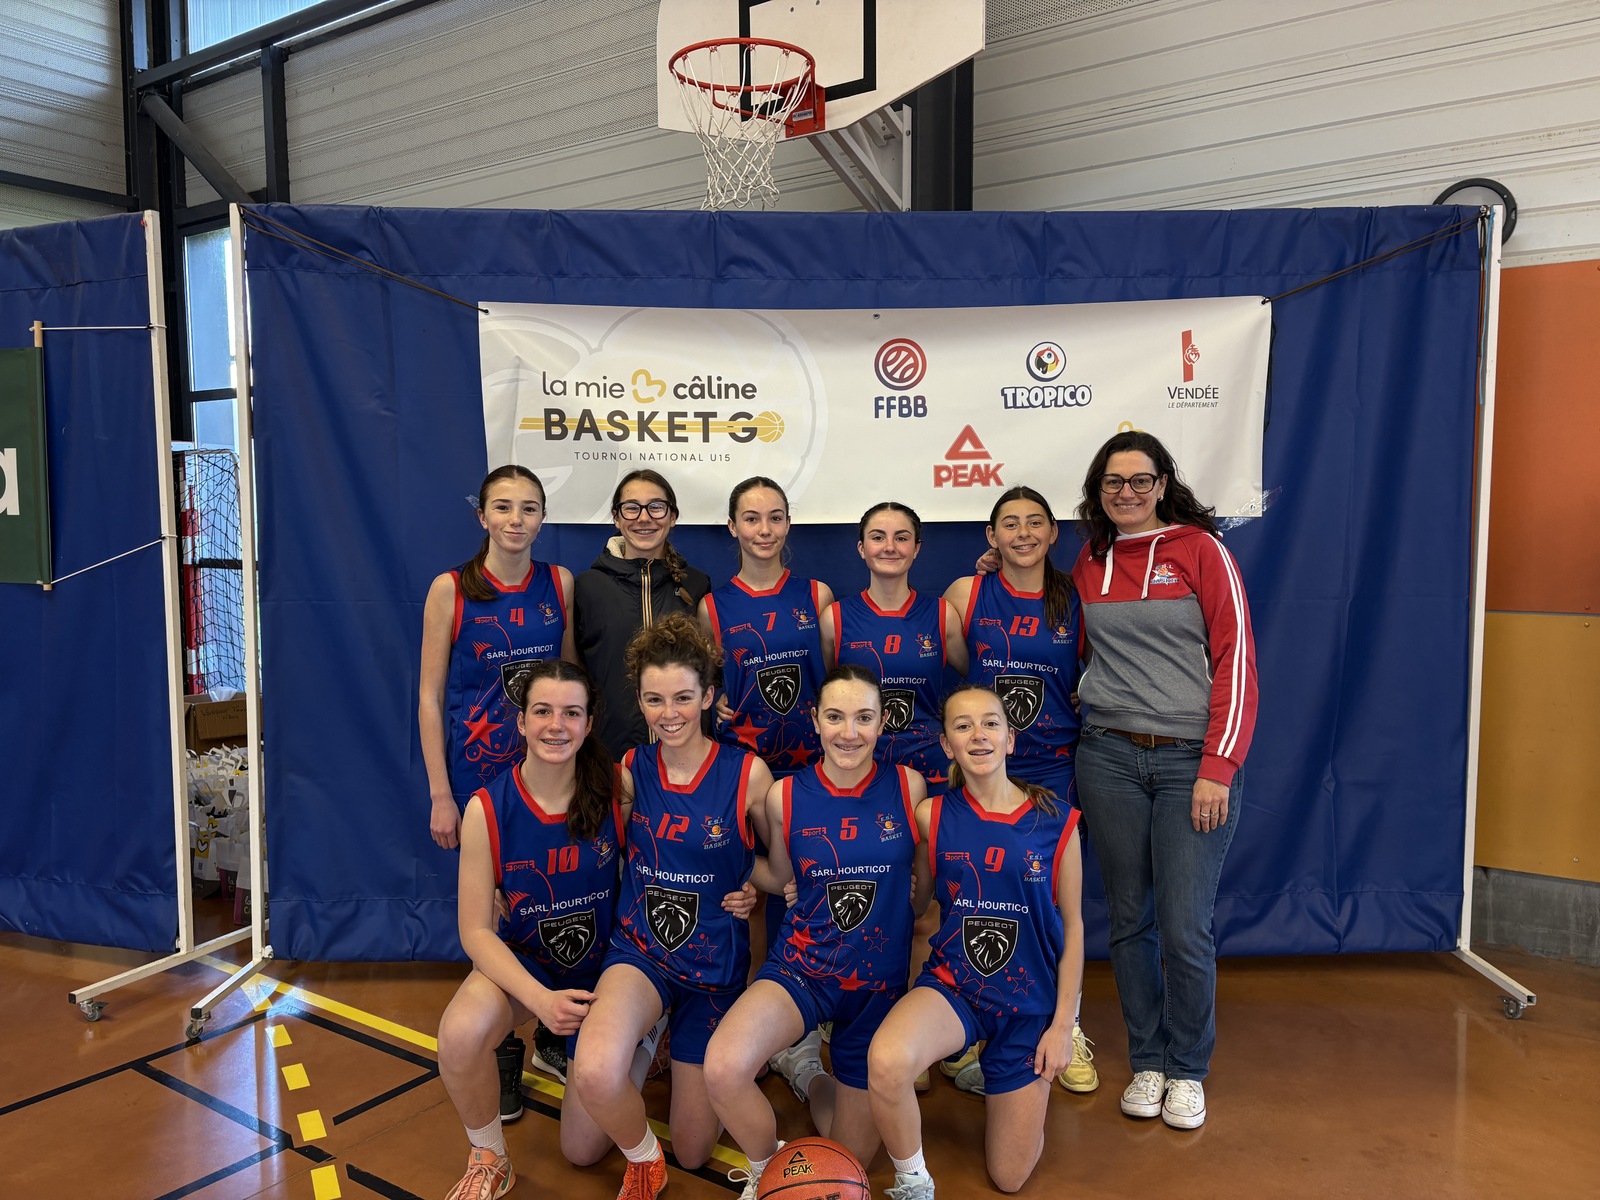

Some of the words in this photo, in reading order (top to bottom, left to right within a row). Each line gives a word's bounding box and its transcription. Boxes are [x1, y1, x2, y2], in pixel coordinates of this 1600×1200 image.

[542, 371, 567, 396] la
[575, 375, 625, 399] mie
[673, 375, 758, 400] câline
[1167, 384, 1219, 400] VENDÉE
[1001, 384, 1092, 409] TROPICO
[874, 395, 928, 419] FFBB
[543, 408, 718, 444] BASKET
[574, 452, 633, 461] TOURNOI
[639, 452, 704, 462] NATIONAL
[710, 453, 731, 462] U15
[933, 463, 1005, 489] PEAK
[509, 607, 524, 627] 4
[762, 611, 777, 632] 7
[1009, 616, 1040, 637] 13
[486, 650, 509, 660] SARL
[510, 643, 554, 657] HOURTICOT
[884, 634, 901, 655] 8
[743, 656, 764, 667] SARL
[765, 649, 809, 662] HOURTICOT
[982, 658, 1004, 668] SARL
[1006, 660, 1059, 675] HOURTICOT
[760, 667, 797, 678] PEUGEOT
[881, 677, 927, 685] HOURTICOT
[655, 812, 690, 843] 12
[839, 817, 859, 841] 5
[703, 838, 731, 850] BASKET
[547, 845, 580, 876] 10
[984, 847, 1006, 873] 9
[655, 869, 716, 884] HOURTICOT
[811, 869, 836, 878] SARL
[838, 865, 892, 875] HOURTICOT
[520, 905, 549, 916] SARL
[551, 889, 610, 911] HOURTICOT
[647, 890, 694, 902] PEUGEOT
[543, 914, 593, 929] PEUGEOT
[967, 920, 1015, 930] PEUGEOT
[783, 1163, 814, 1179] PEAK
